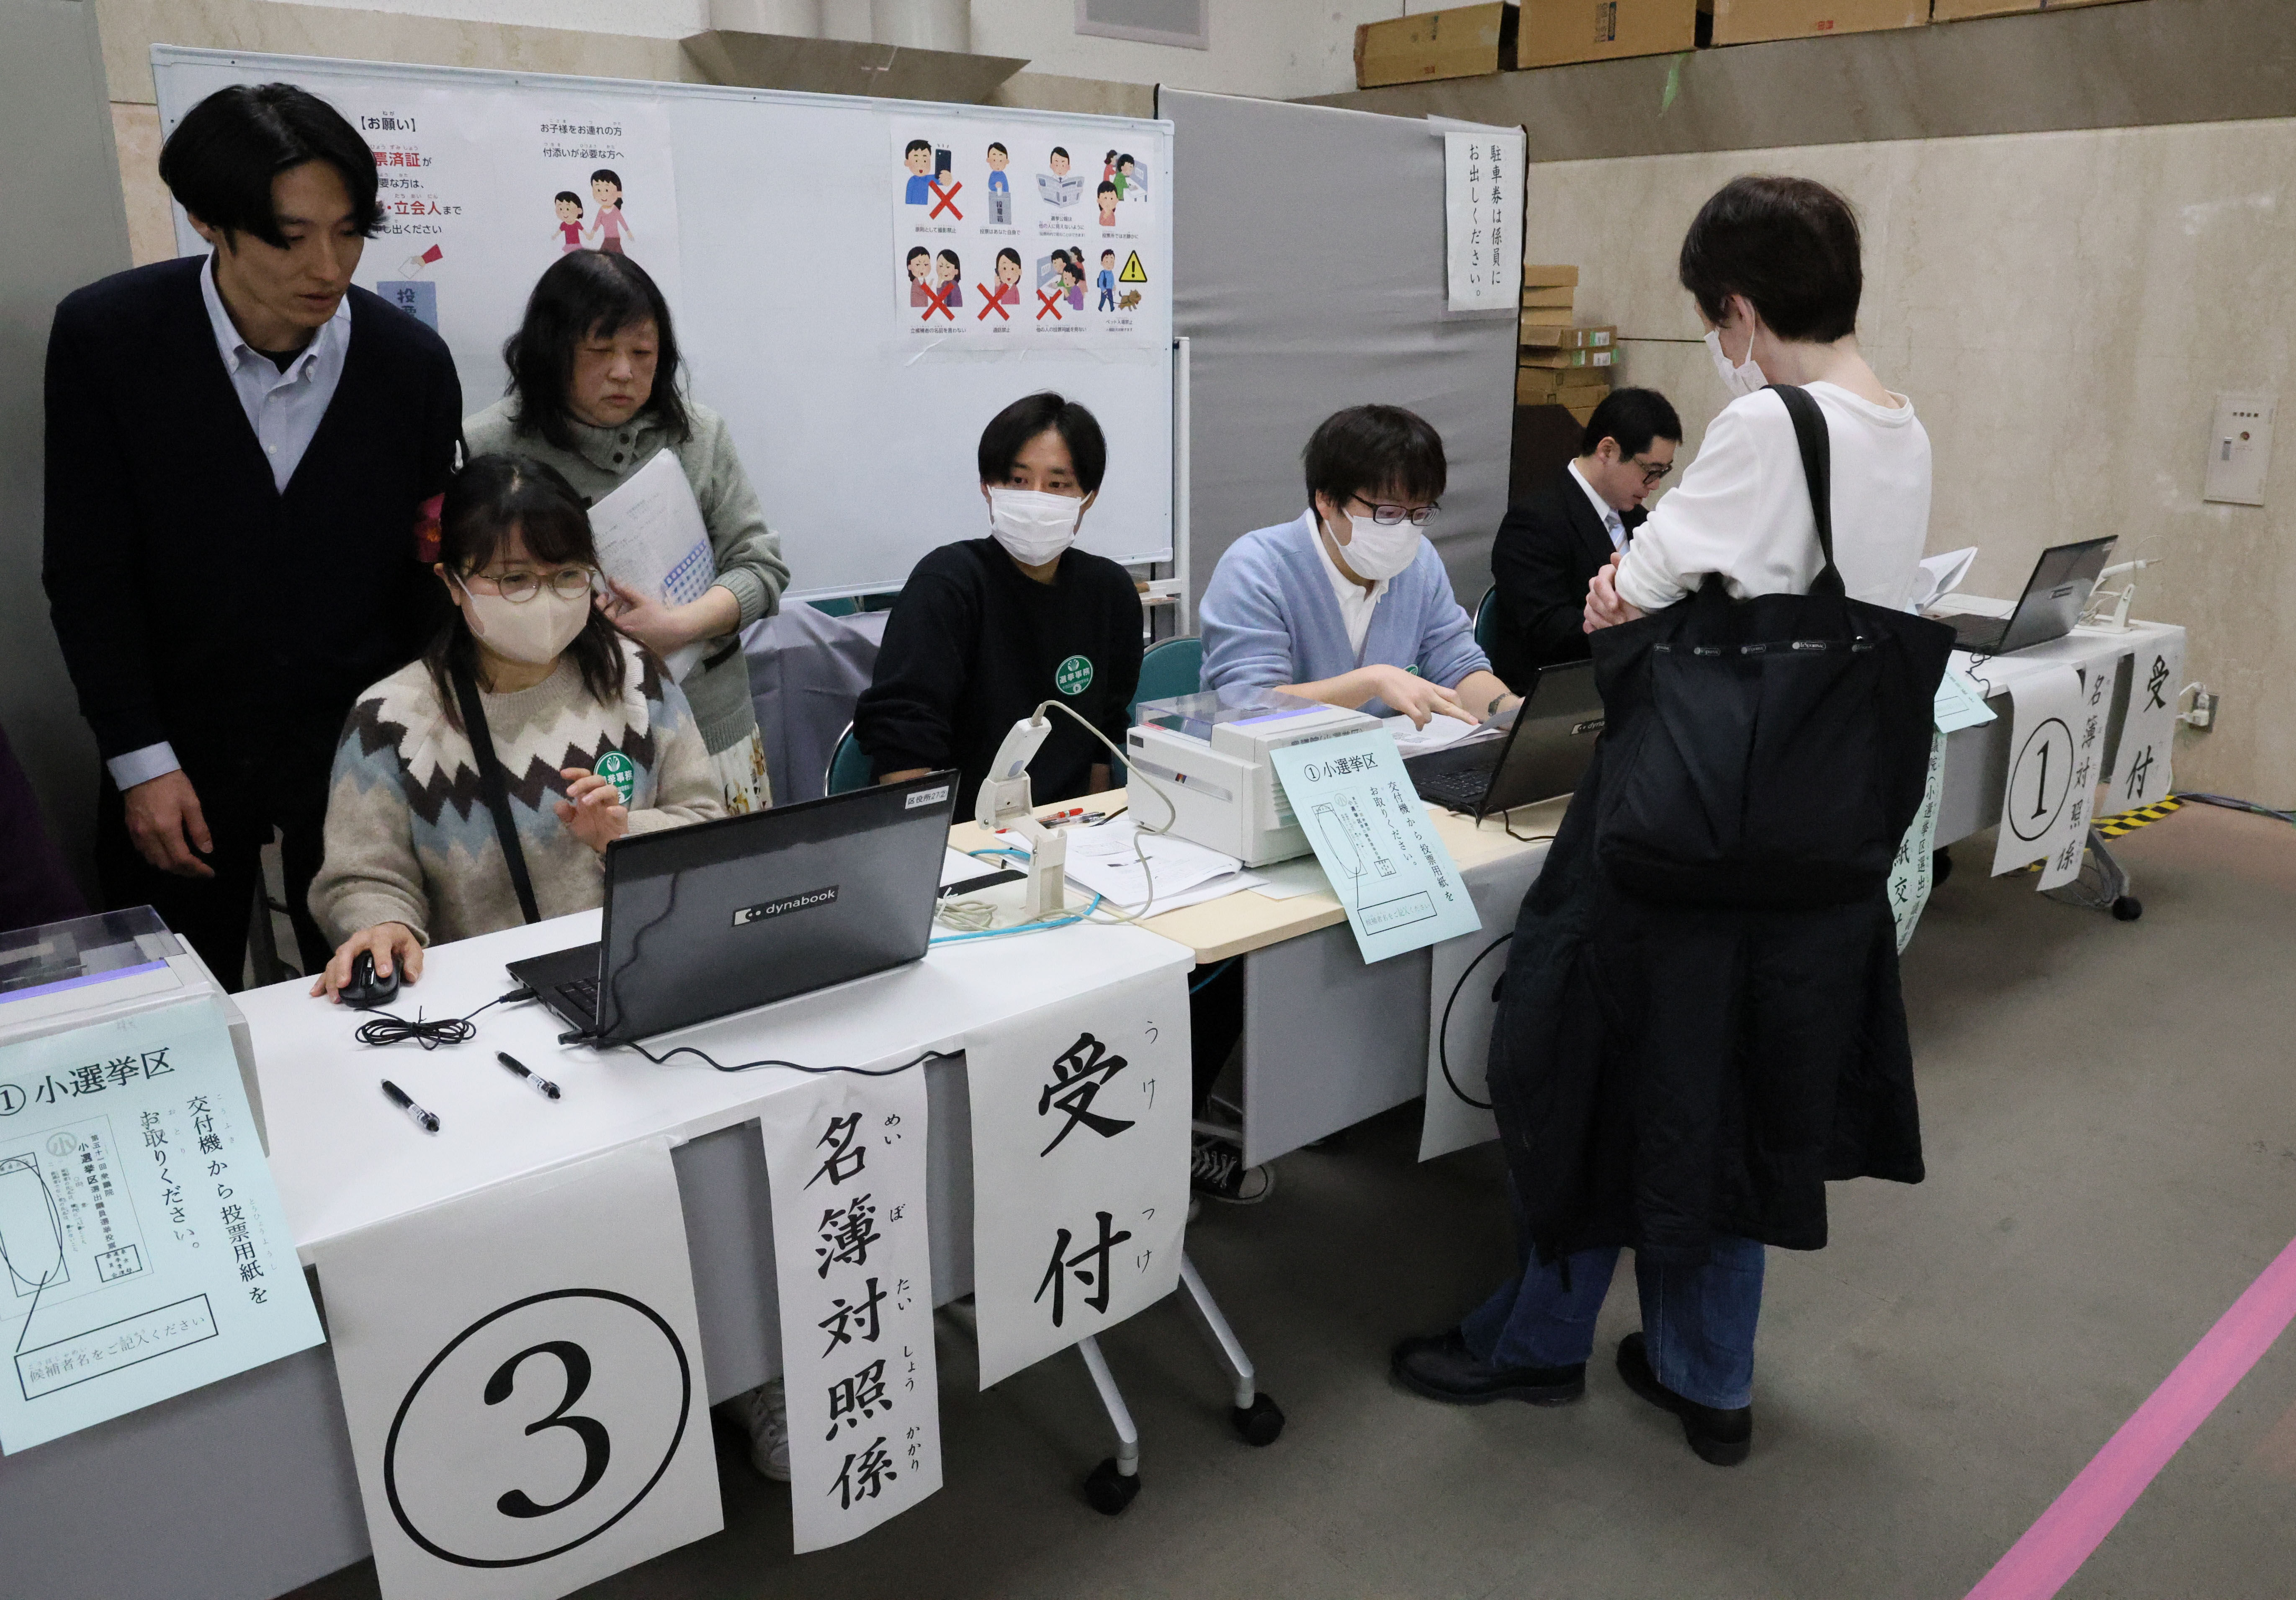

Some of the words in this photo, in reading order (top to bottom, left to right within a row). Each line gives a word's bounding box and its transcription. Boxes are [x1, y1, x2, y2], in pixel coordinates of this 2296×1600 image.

[361, 116, 416, 131] 【お願い】
[541, 124, 621, 136] お子様をお連れの方
[373, 151, 432, 167] 票済証が
[543, 148, 624, 159] 付添いが必要な方へ
[379, 178, 424, 188] 要な方は、
[376, 201, 461, 215] ・立会人まで
[1470, 144, 1481, 296] お出しください。
[1490, 145, 1503, 285] 駐車券は係員に
[2126, 654, 2170, 800] 受付
[602, 770, 633, 786] 挙事務
[1304, 752, 1378, 782] ①小選挙区
[2057, 674, 2105, 871] 名簿対照係
[1370, 787, 1417, 865] お取りください。
[1388, 781, 1454, 901] 交付機から投票用紙を
[766, 889, 835, 914] dynabook
[884, 1113, 902, 1145] めい
[140, 1112, 199, 1248] お取りください。
[187, 1095, 268, 1304] 交付機から投票用紙を
[1034, 1032, 1136, 1327] 受付
[890, 1203, 906, 1222] ぼ
[803, 1111, 897, 1510] 名簿対照係
[896, 1278, 911, 1312] たい
[30, 1317, 205, 1383] 候補者名をご記入ください
[903, 1345, 916, 1392] しょう
[906, 1425, 923, 1473] かかり
